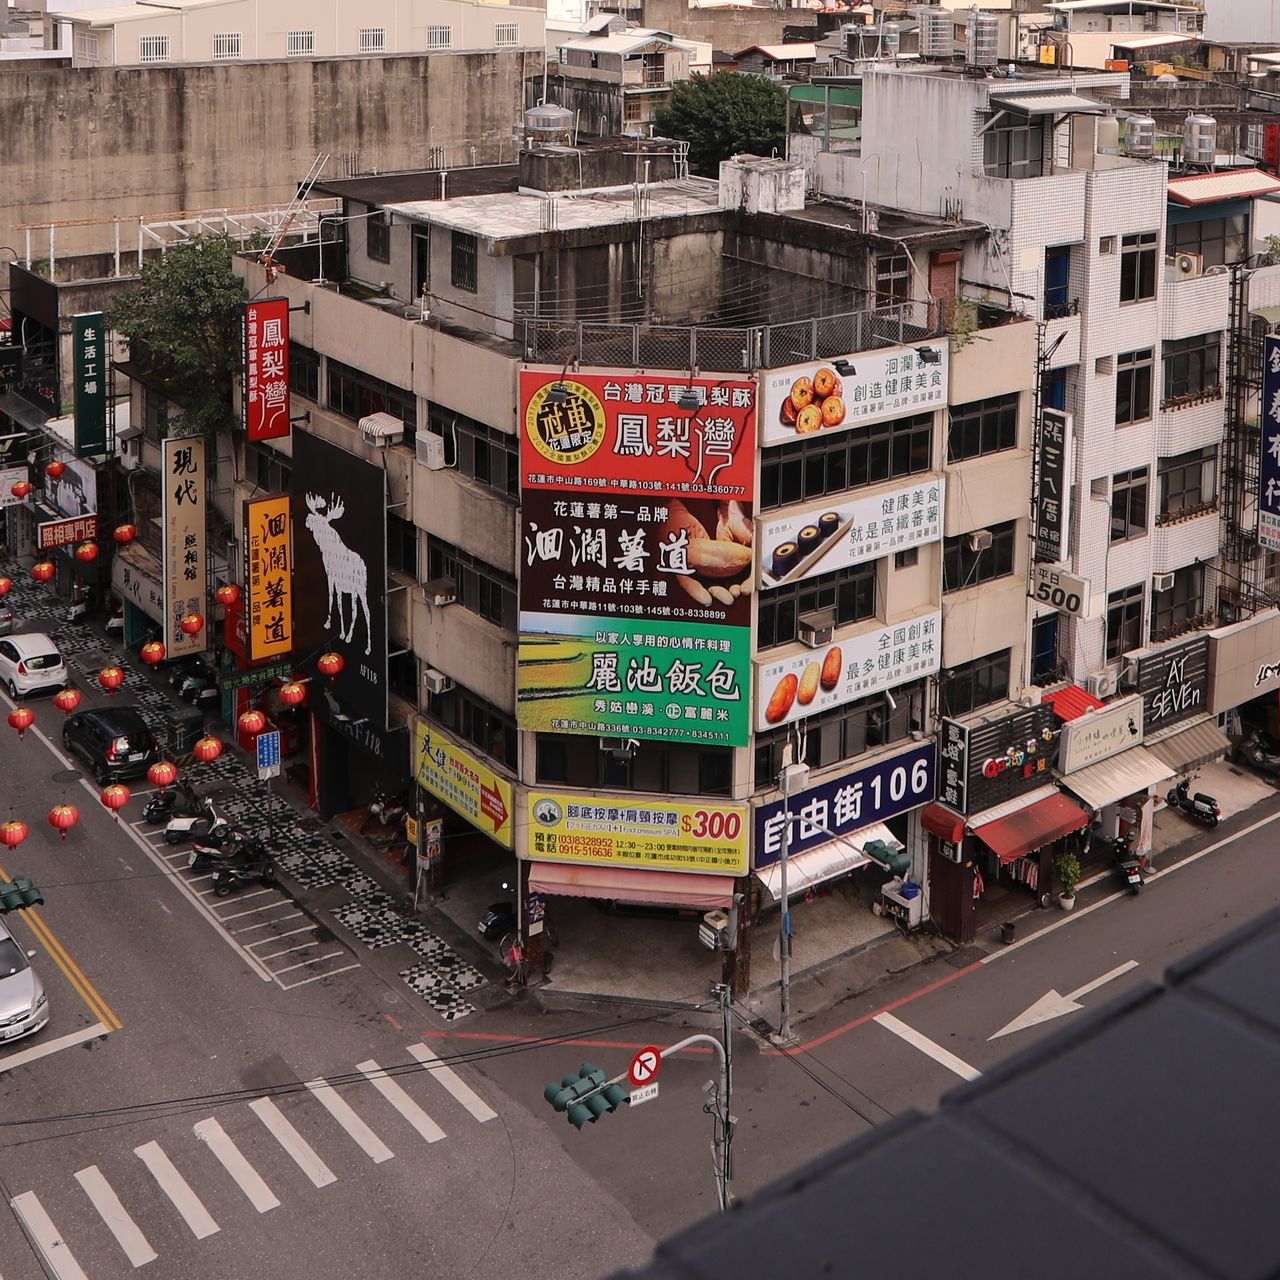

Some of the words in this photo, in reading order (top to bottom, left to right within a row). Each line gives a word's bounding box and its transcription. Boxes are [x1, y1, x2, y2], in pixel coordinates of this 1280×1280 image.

[84, 328, 97, 394] 生活工場
[258, 319, 286, 430] 鳳梨灣
[603, 381, 752, 408] 台灣冠軍鳳梨酥
[853, 370, 943, 403] 創造健康美食
[549, 431, 593, 451] 花蓮限定
[613, 413, 735, 485] 鳳梨灣
[173, 446, 198, 506] 現代
[553, 501, 669, 523] 花蓮薯第一品牌
[882, 486, 939, 516] 健康美食
[42, 520, 96, 546] 照相專門店
[1039, 526, 1060, 542] 民宿
[525, 522, 696, 575] 洄瀾薯道
[261, 513, 290, 644] 洄瀾薯道
[553, 574, 667, 597] 台灣精品伴手禮
[1038, 568, 1059, 586] 平日
[1036, 582, 1081, 612] 500
[595, 631, 731, 653] 以家人享用的心情作料理
[878, 618, 936, 652] 全國創新
[846, 638, 935, 681] 最多健康美味
[1166, 654, 1189, 688] AT
[586, 652, 740, 701] 麗池飯包
[567, 805, 678, 826] 腳底按摩+肩頸按摩
[682, 810, 741, 840] $300
[535, 832, 556, 844] 預約
[558, 835, 613, 849] (03)8328952
[535, 842, 557, 854] 電話
[559, 846, 613, 858] 0915-516636
